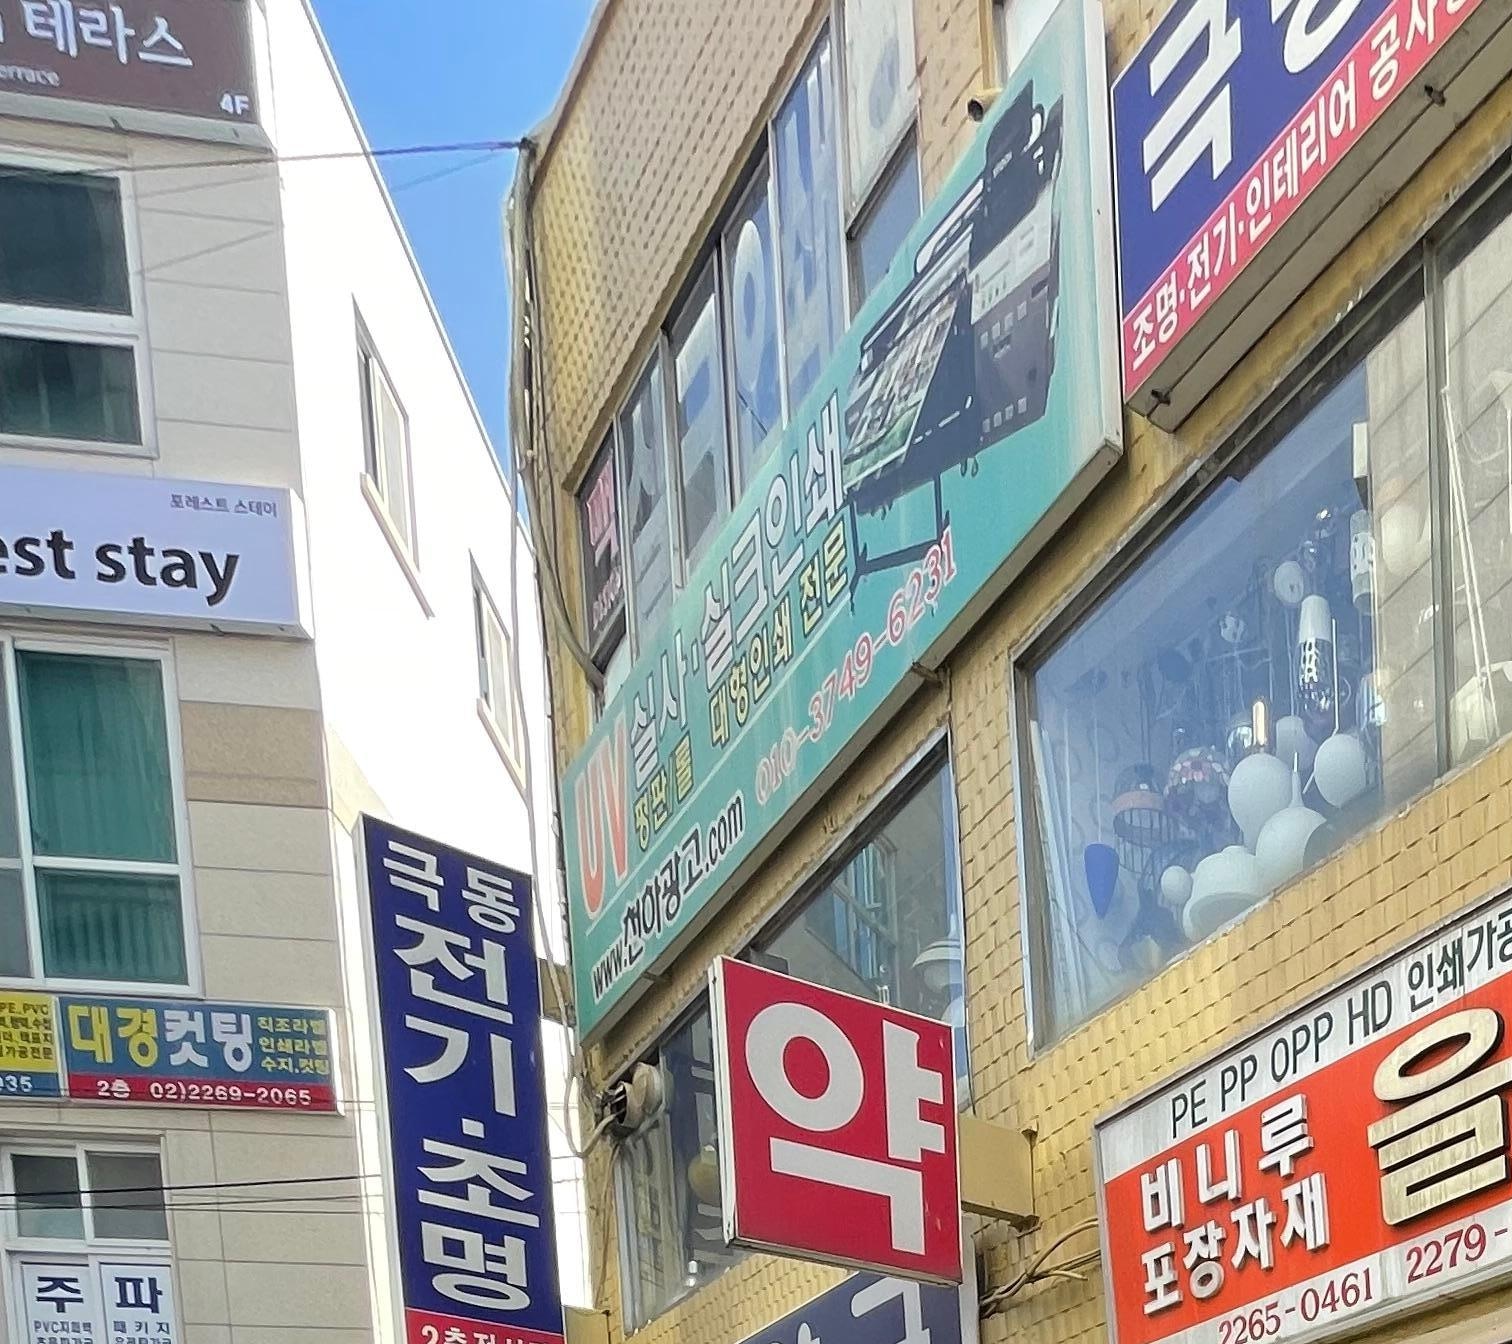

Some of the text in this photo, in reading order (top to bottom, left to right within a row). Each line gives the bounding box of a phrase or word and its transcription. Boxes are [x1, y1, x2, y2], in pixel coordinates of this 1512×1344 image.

[219, 93, 250, 115] 4F
[94, 536, 240, 606] stay
[708, 603, 795, 748] 대형인쇄
[799, 514, 850, 638] 전문
[755, 526, 957, 807] 010-3749-6231
[575, 712, 630, 918] UV
[22, 1003, 49, 1016] PVC
[67, 1004, 253, 1073] 대경컷팅
[1170, 1079, 1208, 1139] PE
[1219, 1054, 1259, 1119] PP
[1270, 1012, 1334, 1085] OPP
[1348, 981, 1394, 1045] HD
[97, 1079, 313, 1106] 2층 02)2269-2065
[745, 1002, 947, 1256] 약
[1140, 1093, 1315, 1234] 비니루
[35, 1275, 85, 1313] 주
[113, 1276, 164, 1315] 파
[1142, 1173, 1330, 1318] 포장자재
